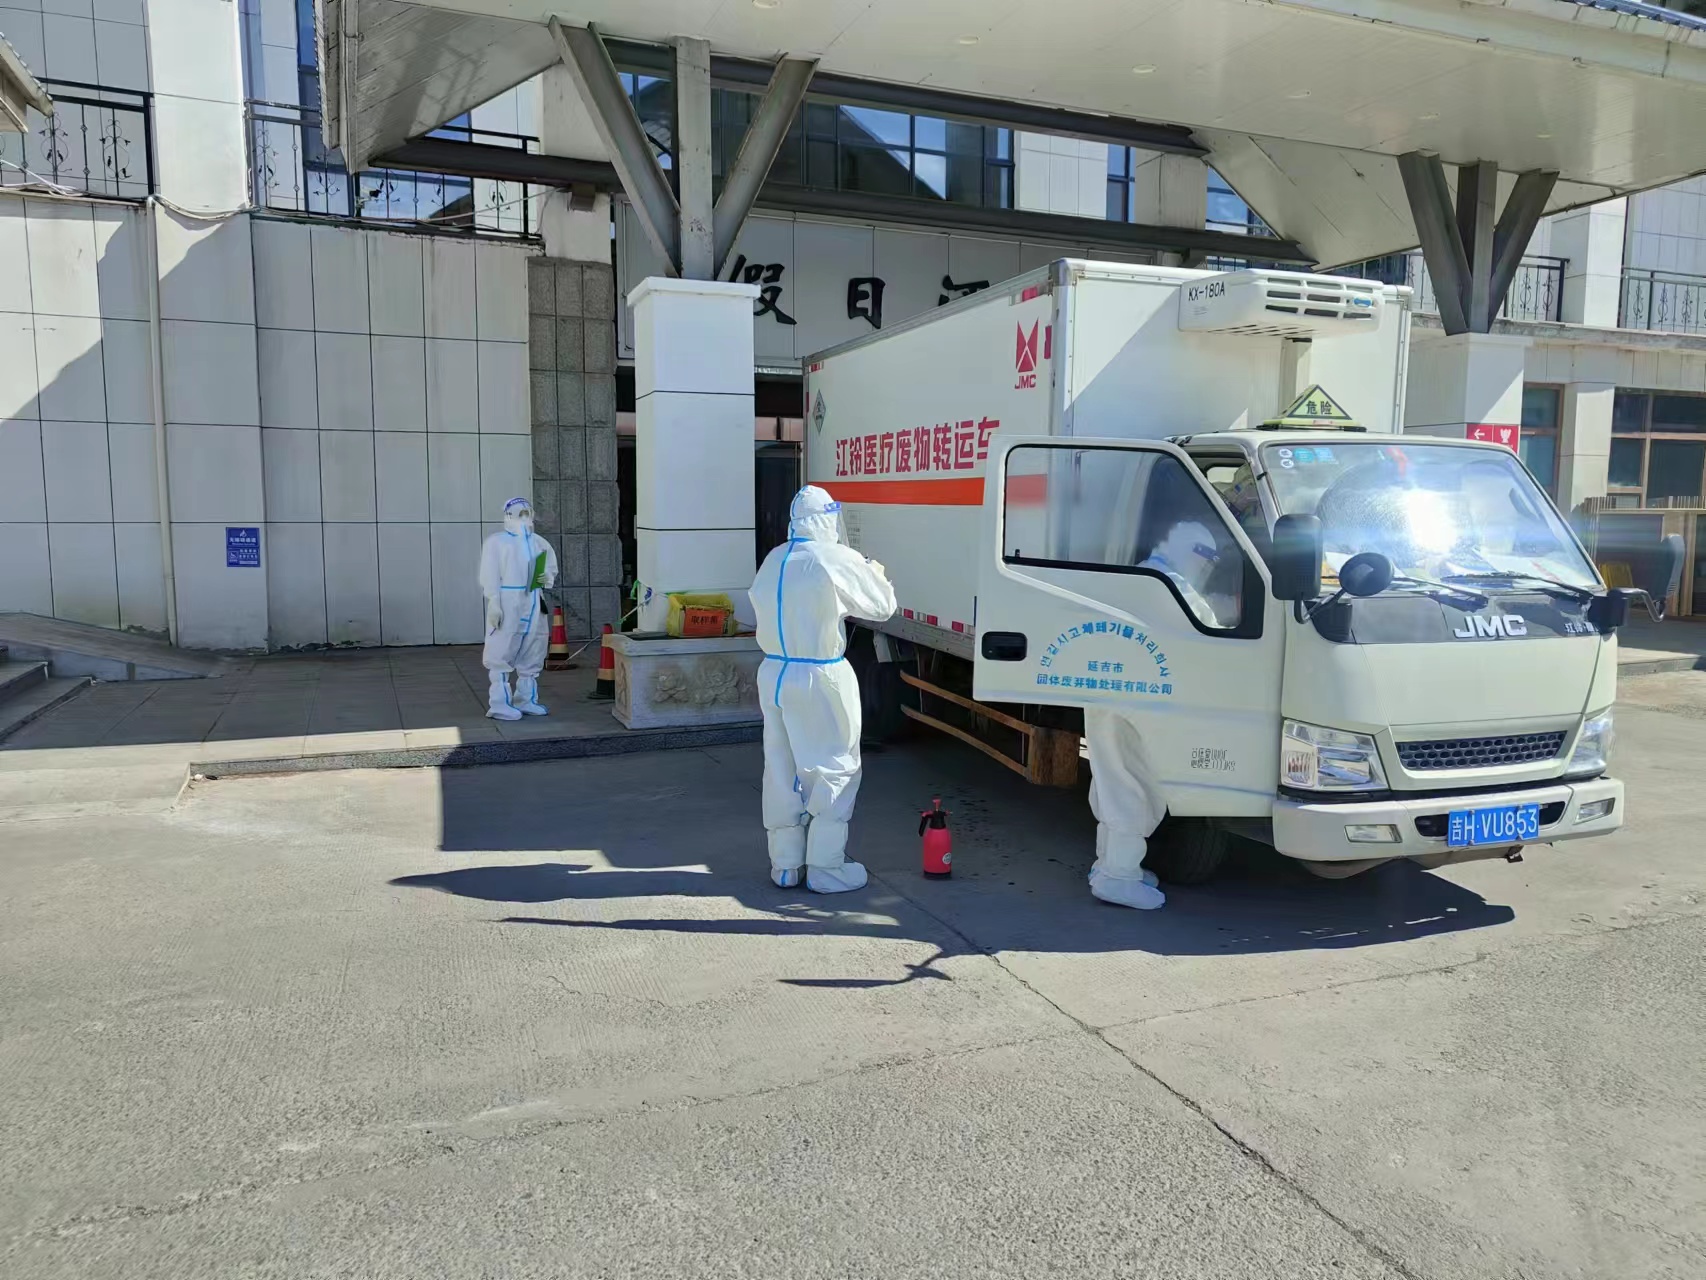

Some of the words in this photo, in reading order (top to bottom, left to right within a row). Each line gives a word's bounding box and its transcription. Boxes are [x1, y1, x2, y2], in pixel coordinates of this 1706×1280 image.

[1188, 281, 1225, 301] KX-180A
[1015, 374, 1036, 389] JMC
[1306, 400, 1332, 415] 危险
[836, 416, 1000, 476] 江铃医疗废物转运车
[1454, 614, 1527, 638] JMC
[1087, 660, 1124, 673] 延吉市
[1036, 673, 1172, 695] 固体废弃物处理有限公司
